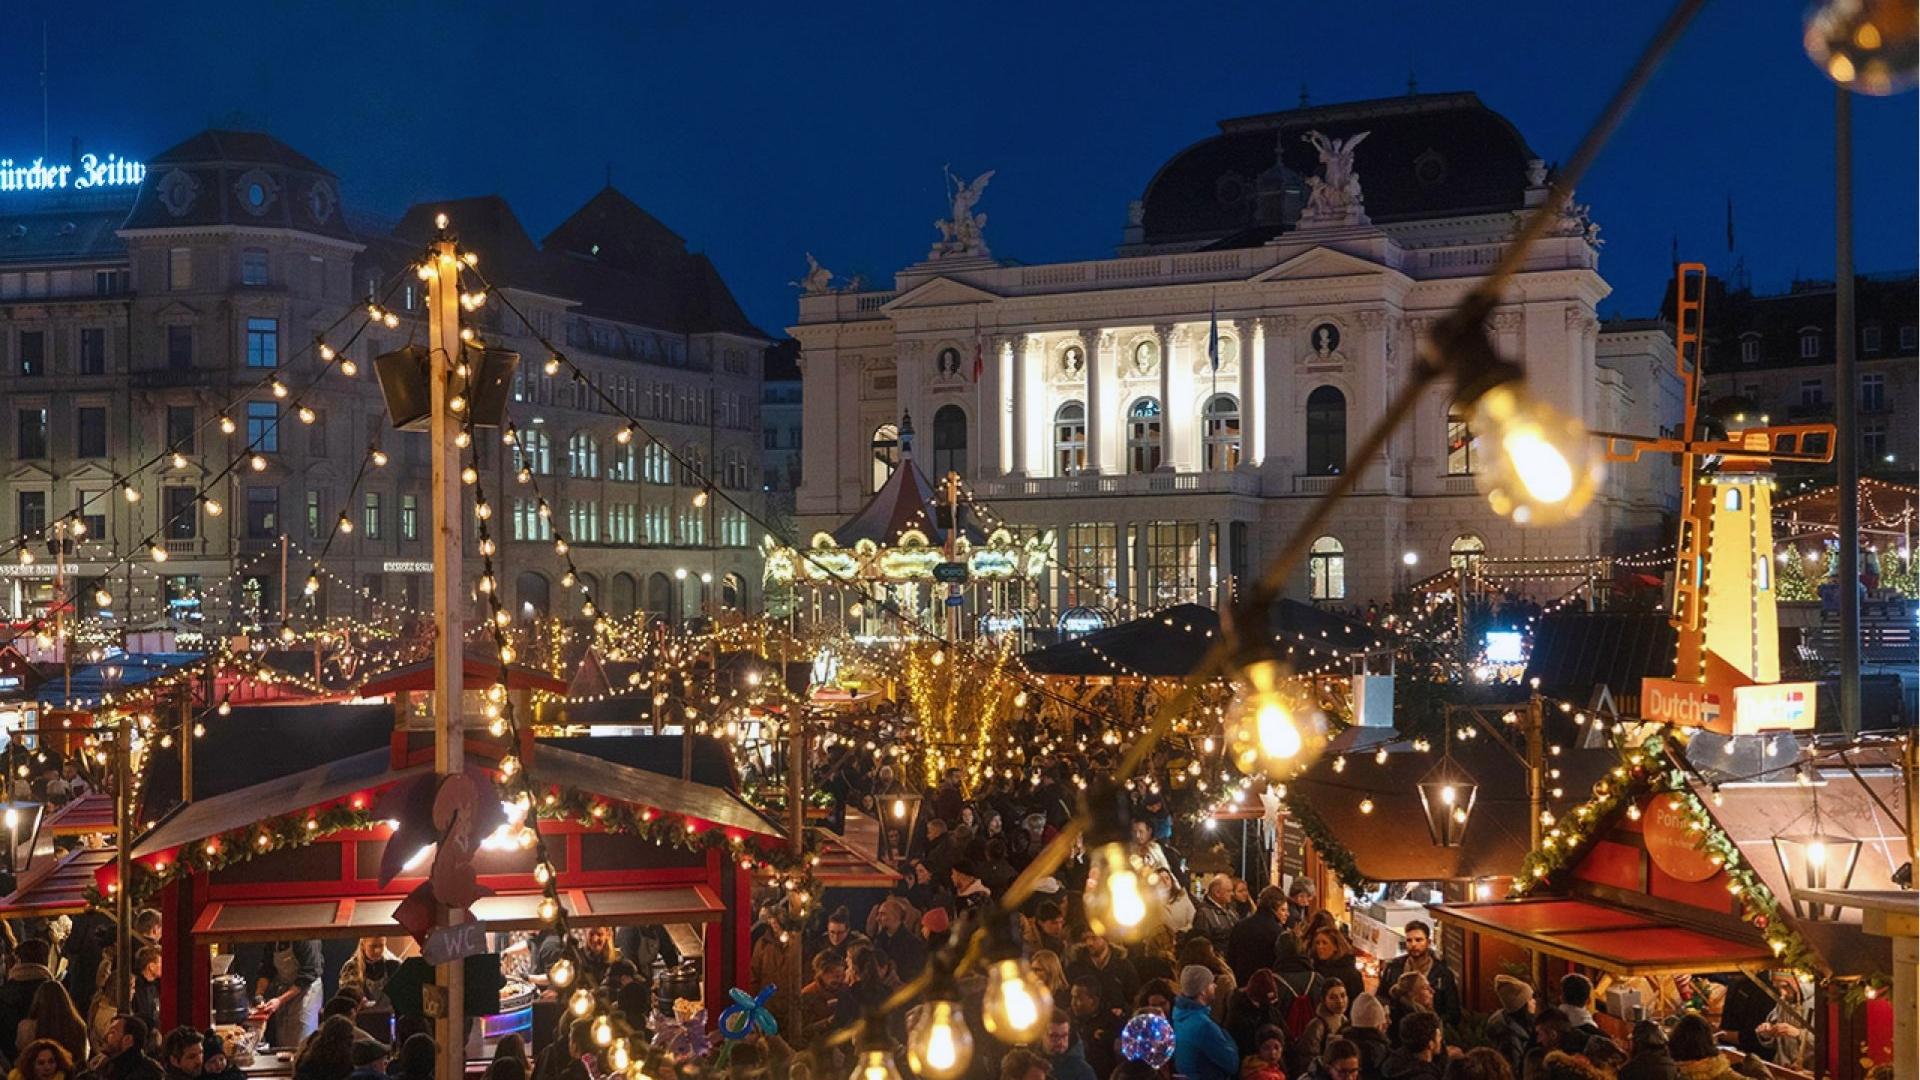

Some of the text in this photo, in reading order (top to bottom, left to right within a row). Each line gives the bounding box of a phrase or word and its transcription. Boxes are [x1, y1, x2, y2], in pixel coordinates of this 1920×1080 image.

[1650, 688, 1700, 719] Dutch
[1657, 809, 1687, 828] Pomm
[443, 926, 475, 956] WC
